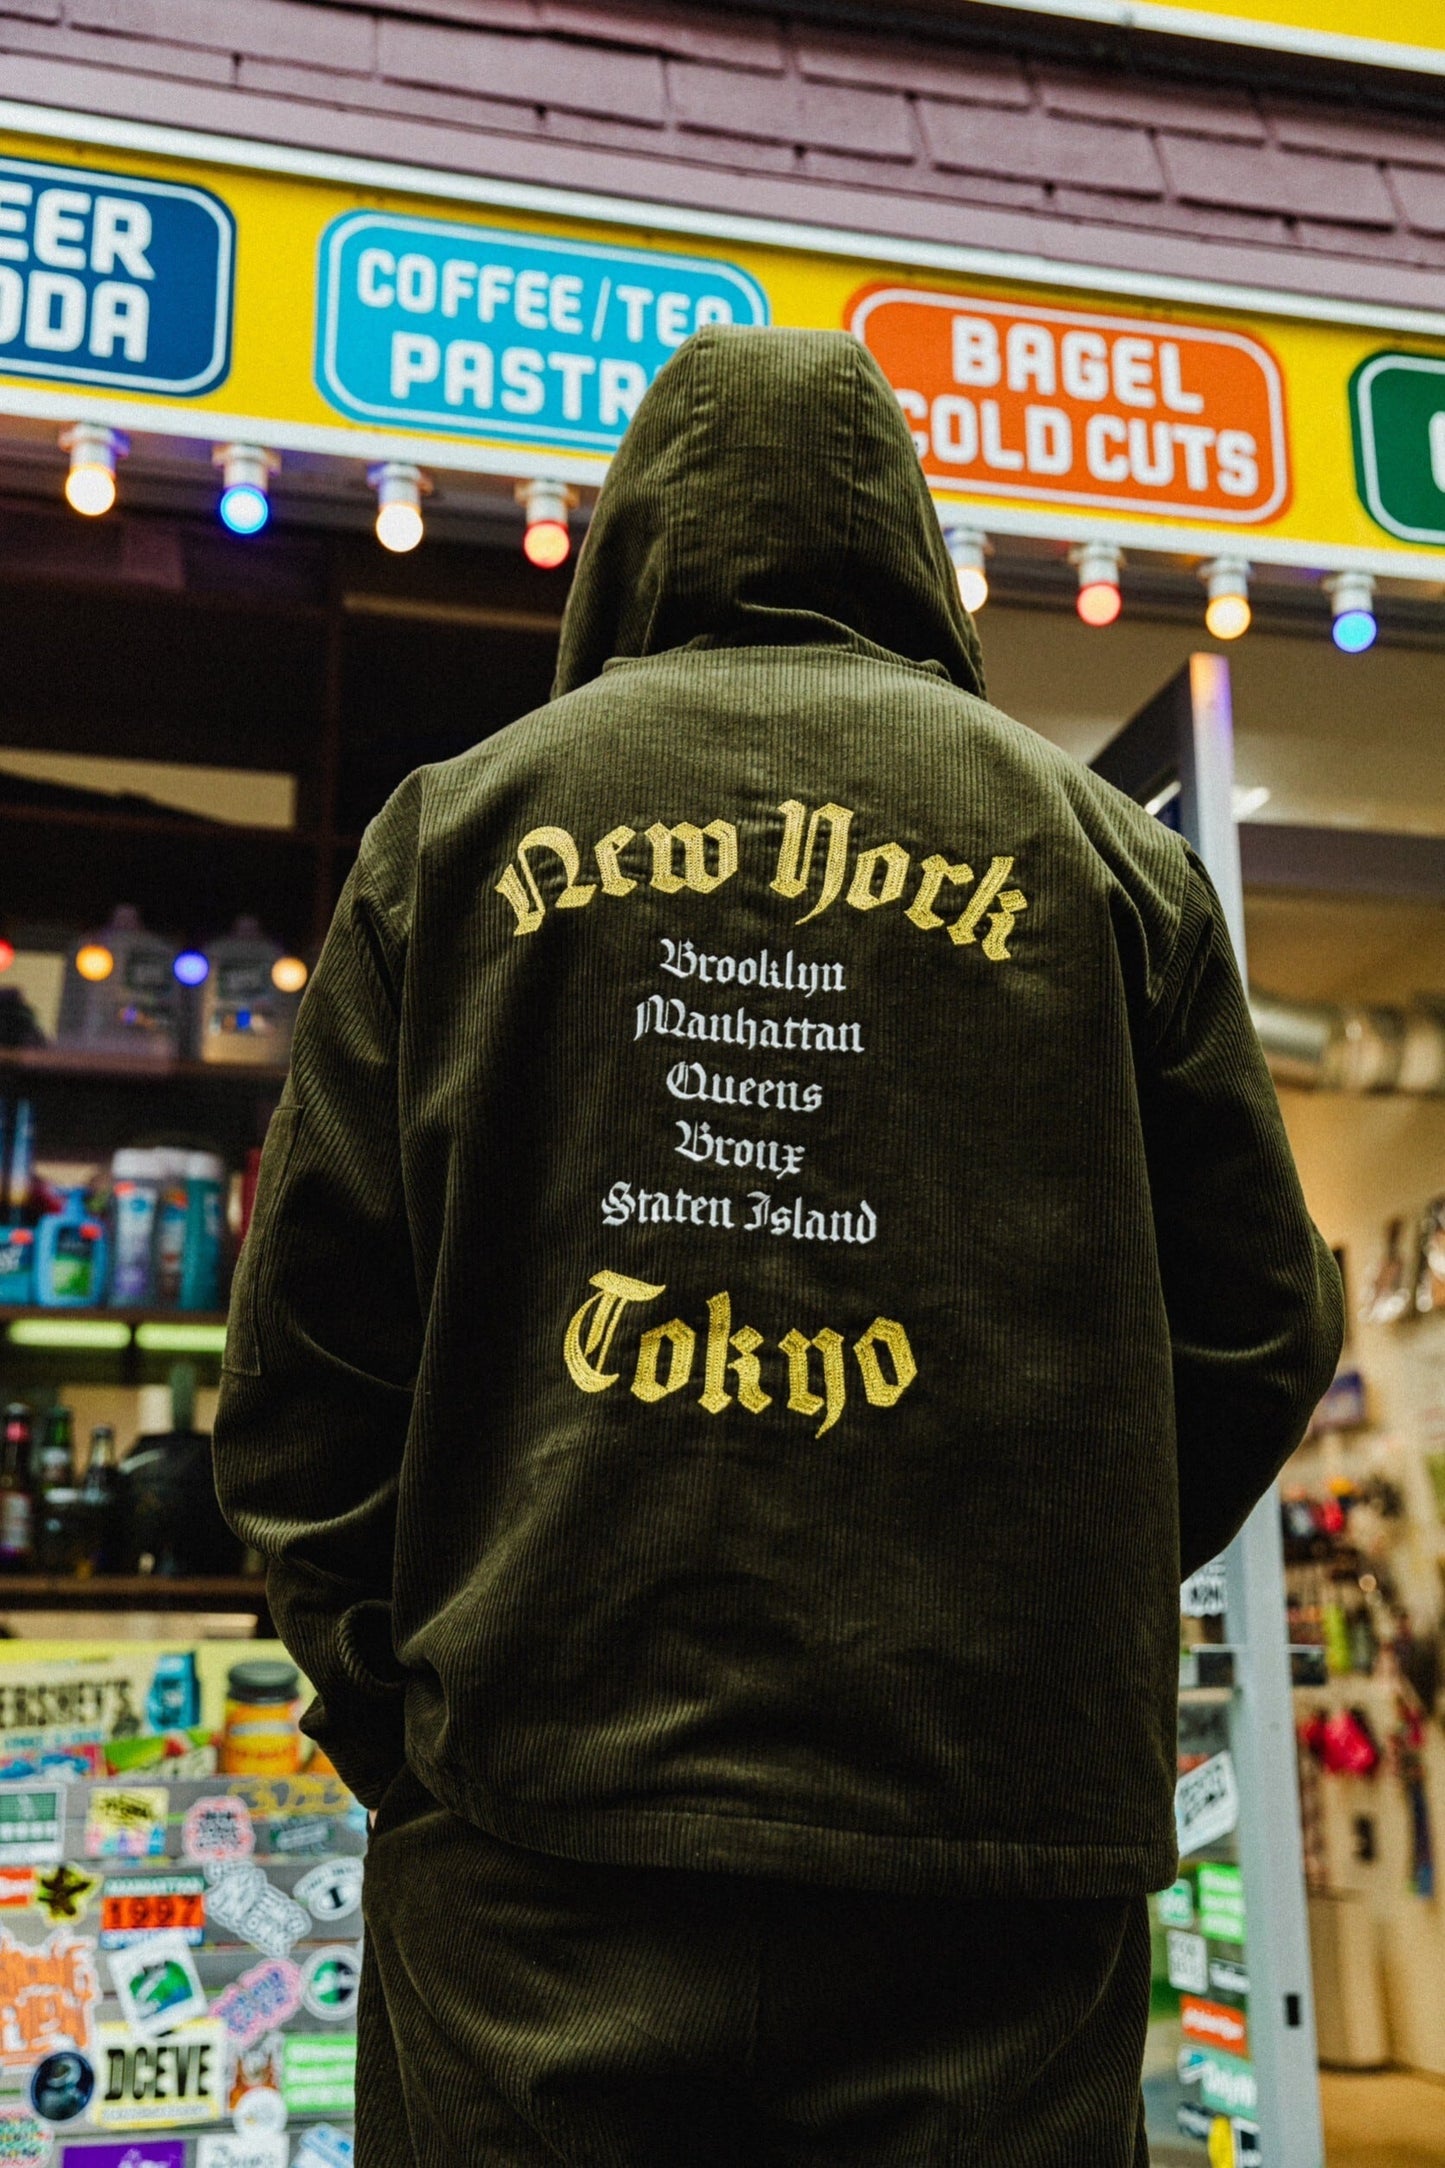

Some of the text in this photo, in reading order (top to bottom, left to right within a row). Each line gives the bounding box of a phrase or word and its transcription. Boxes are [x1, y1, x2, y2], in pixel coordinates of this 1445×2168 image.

[390, 331, 662, 427] PASTR
[951, 315, 1204, 414] BAGEL
[1086, 414, 1258, 498] CUTS
[495, 799, 1028, 961] New York
[659, 938, 847, 999] Brooklyn
[633, 994, 866, 1054] Manhattan
[665, 1061, 824, 1113] Queens
[674, 1120, 806, 1180] Bronx
[600, 1180, 878, 1246] Staten Island
[563, 1269, 919, 1440] Tokyo
[110, 1895, 202, 1929] 1997
